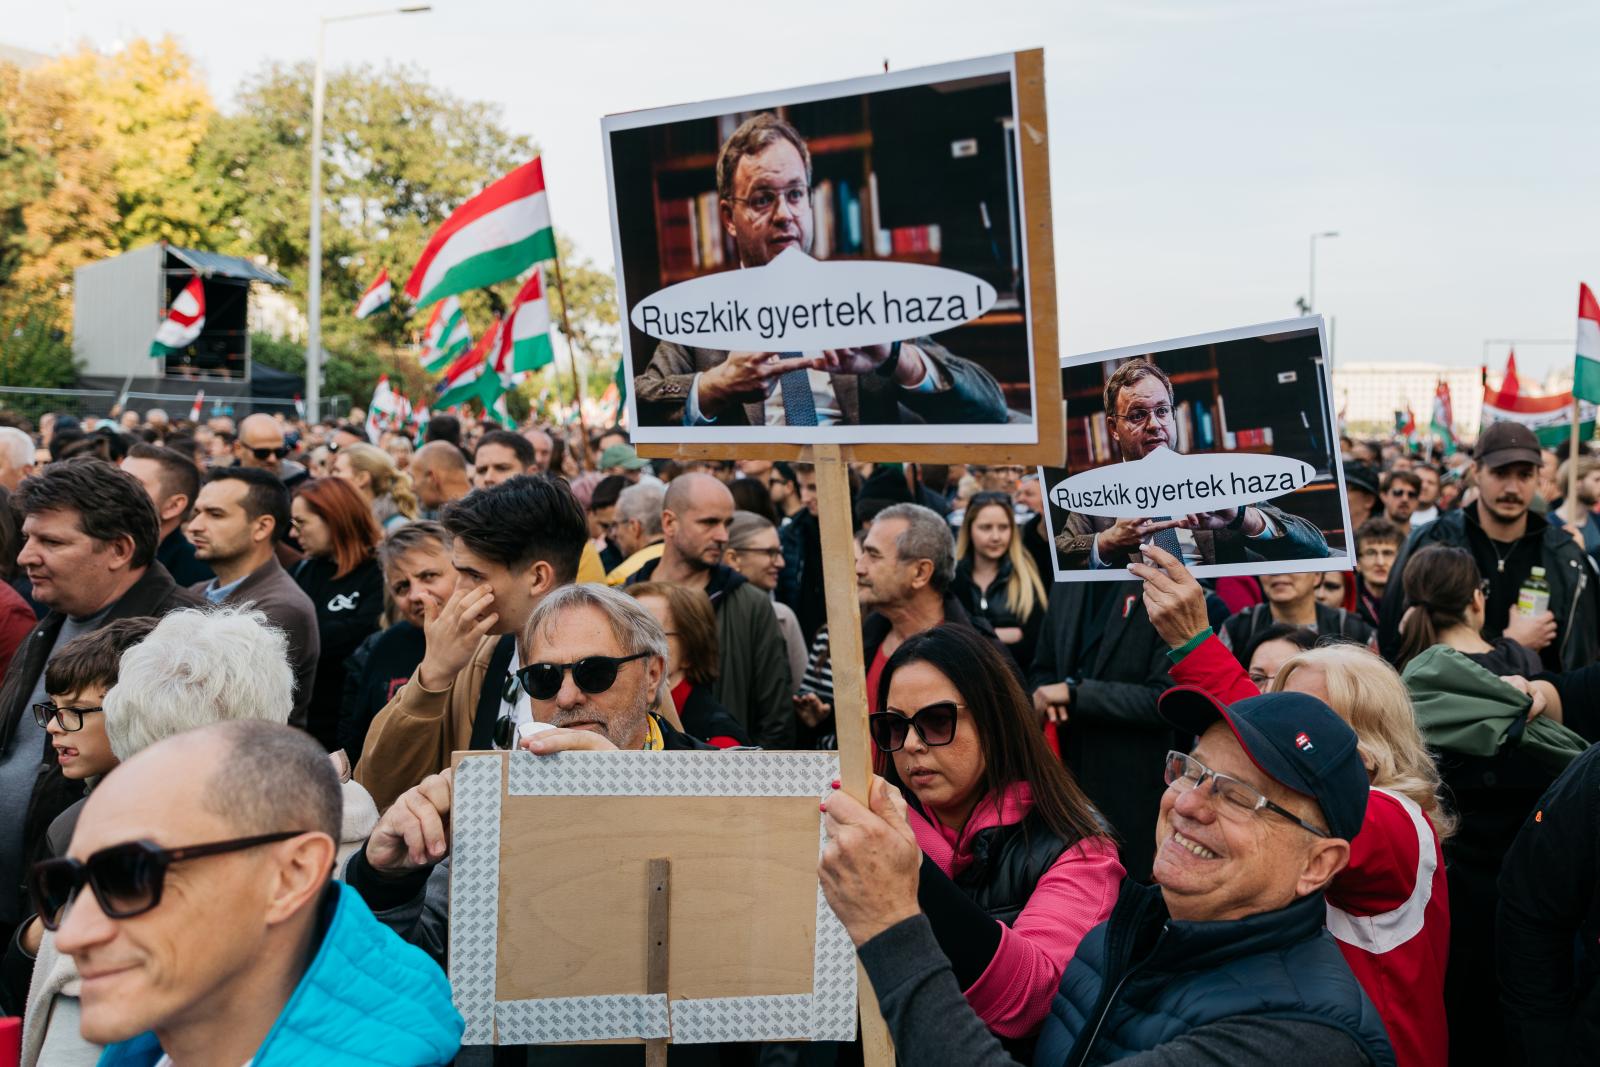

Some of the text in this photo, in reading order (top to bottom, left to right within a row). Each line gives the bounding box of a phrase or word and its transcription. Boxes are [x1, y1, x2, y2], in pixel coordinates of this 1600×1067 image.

[642, 300, 752, 335] Ruszkik
[757, 292, 876, 339] gyertek
[1056, 483, 1132, 509] Ruszkik
[1135, 474, 1226, 509] gyertek
[819, 911, 831, 923] 3M
[818, 925, 830, 937] 3M
[832, 924, 844, 936] 3M
[817, 938, 830, 950] 3M
[831, 938, 843, 950] 3M
[817, 951, 829, 963] 3M
[831, 951, 843, 963] 3M
[844, 950, 856, 962] 3M
[816, 964, 829, 976] 3M
[830, 964, 842, 976] 3M
[843, 964, 856, 976] 3M
[816, 977, 828, 989] 3M
[829, 977, 842, 989] 3M
[843, 977, 855, 989] 3M
[815, 991, 828, 1003] 3M
[829, 990, 842, 1002] 3M
[842, 990, 855, 1002] 3M
[815, 1004, 827, 1016] 3M
[828, 1004, 841, 1016] 3M
[841, 1004, 854, 1016] 3M
[814, 1017, 827, 1029] 3M
[828, 1017, 840, 1029] 3M
[841, 1017, 853, 1029] 3M
